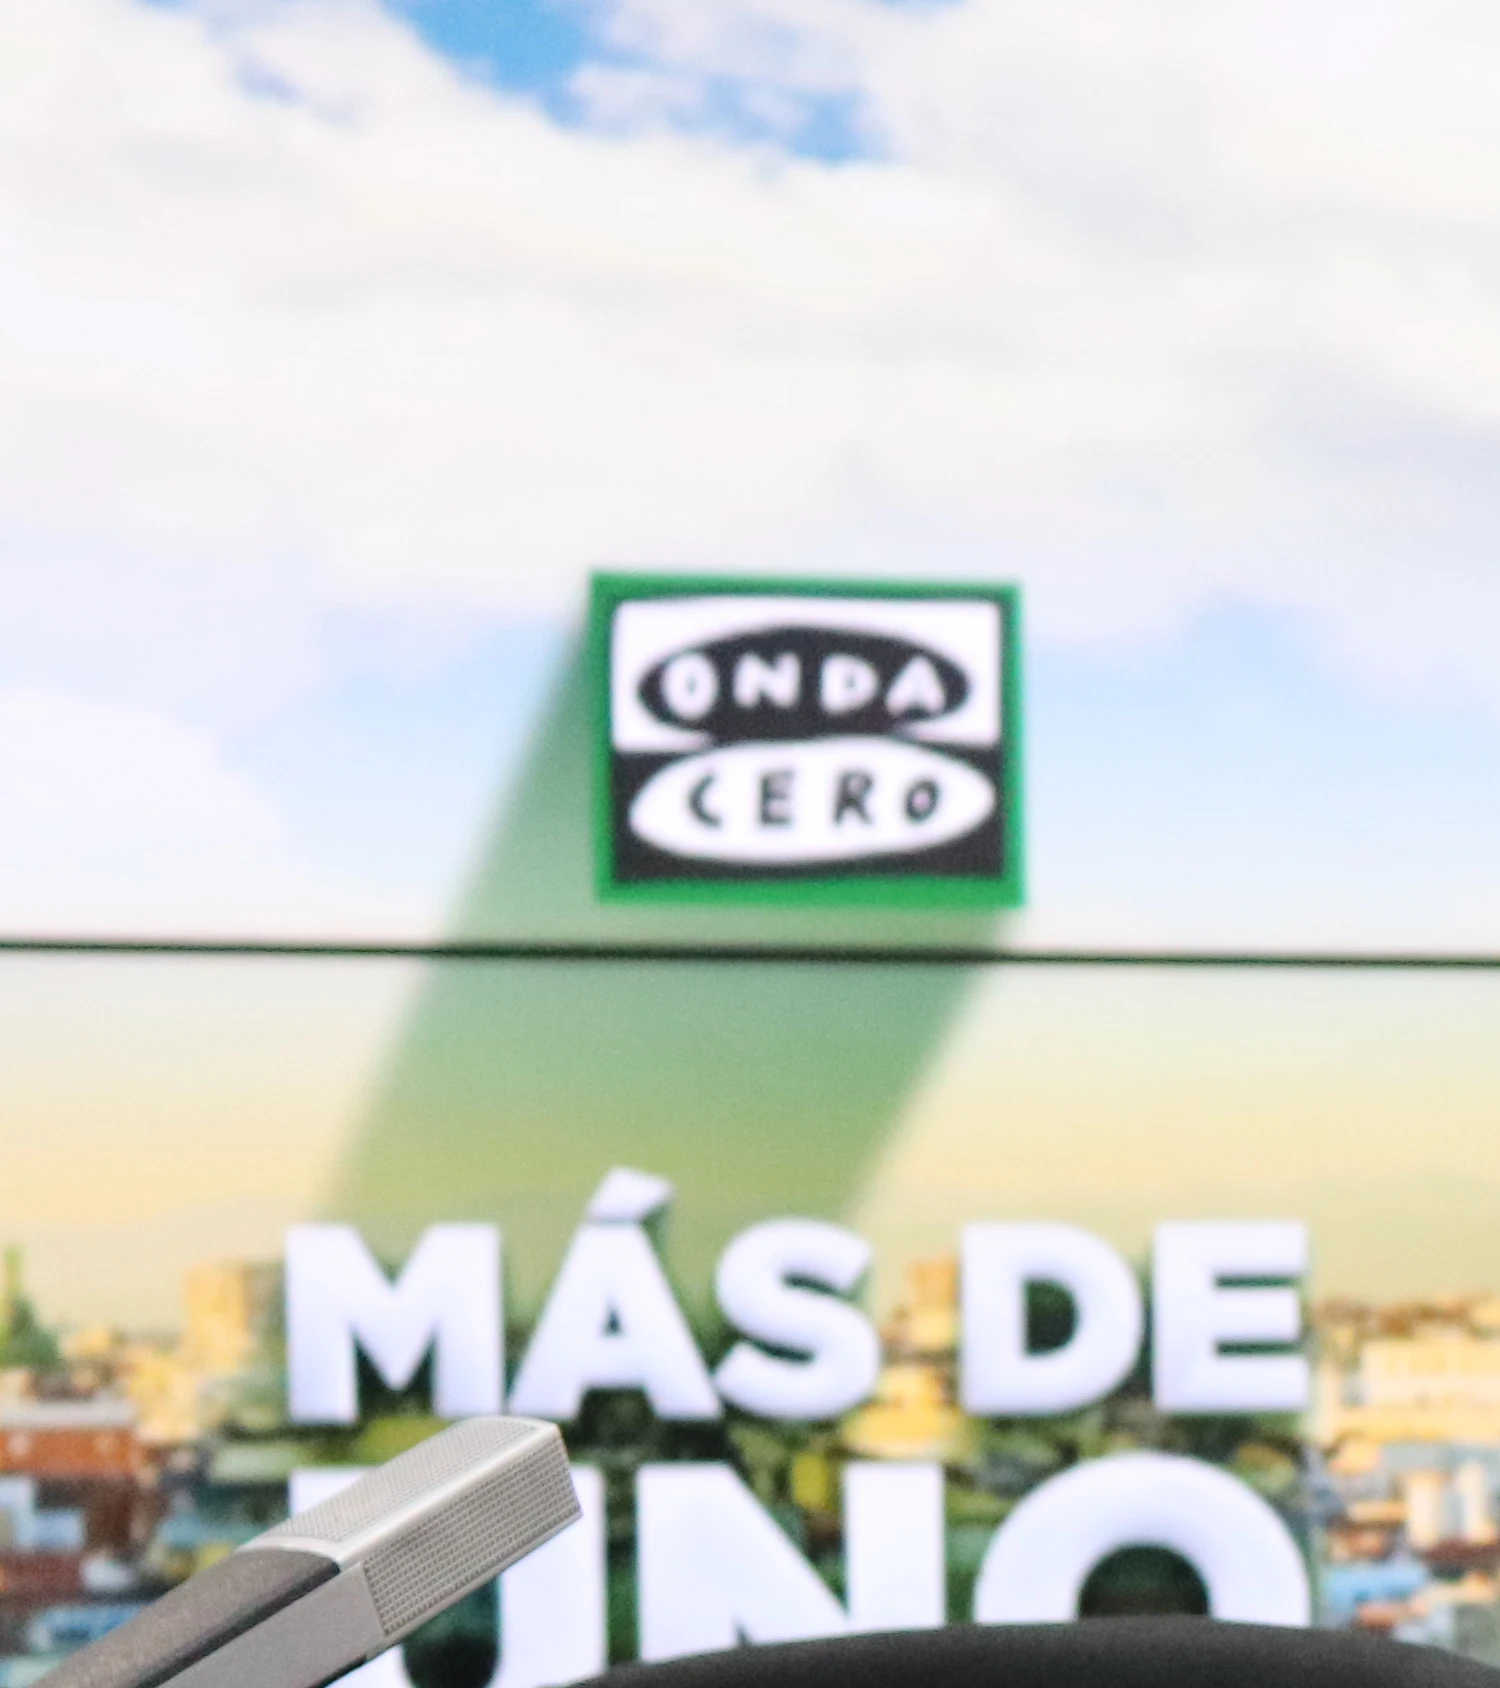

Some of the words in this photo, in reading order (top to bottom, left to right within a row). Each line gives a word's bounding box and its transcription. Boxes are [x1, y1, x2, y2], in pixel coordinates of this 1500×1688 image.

[660, 651, 948, 722] ONDA
[686, 768, 941, 829] CERO
[284, 1166, 882, 1424] MÁS
[960, 1219, 1309, 1415] DE
